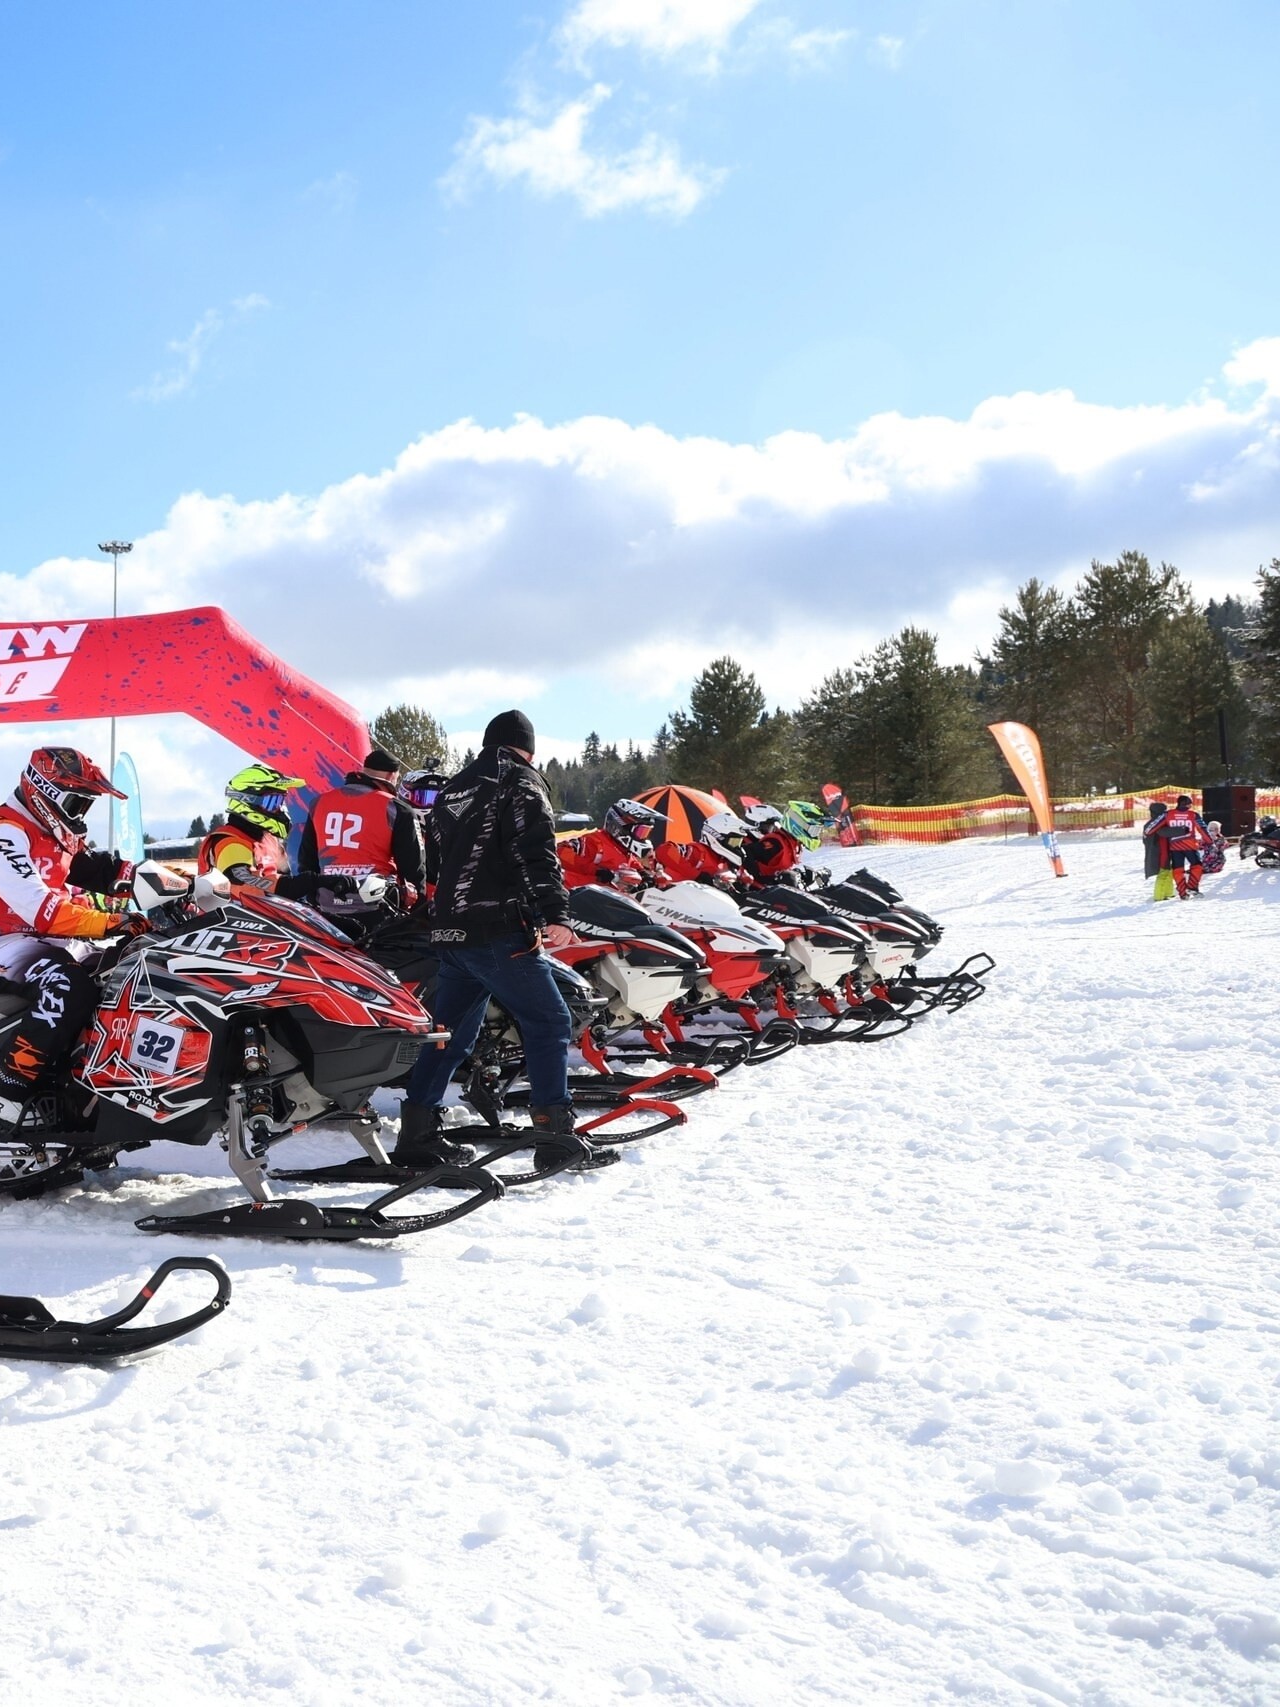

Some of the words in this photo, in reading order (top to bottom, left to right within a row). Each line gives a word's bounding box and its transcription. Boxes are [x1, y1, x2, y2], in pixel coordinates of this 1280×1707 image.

[32, 774, 60, 801] FXR
[324, 812, 363, 849] 92
[655, 906, 693, 923] LYNX
[756, 908, 795, 923] LYNX
[826, 904, 859, 920] LYNX
[231, 920, 268, 932] LYNX
[568, 918, 602, 936] YNX
[430, 929, 468, 942] FXR
[136, 1030, 176, 1064] 32
[128, 1090, 161, 1109] ROTAX
